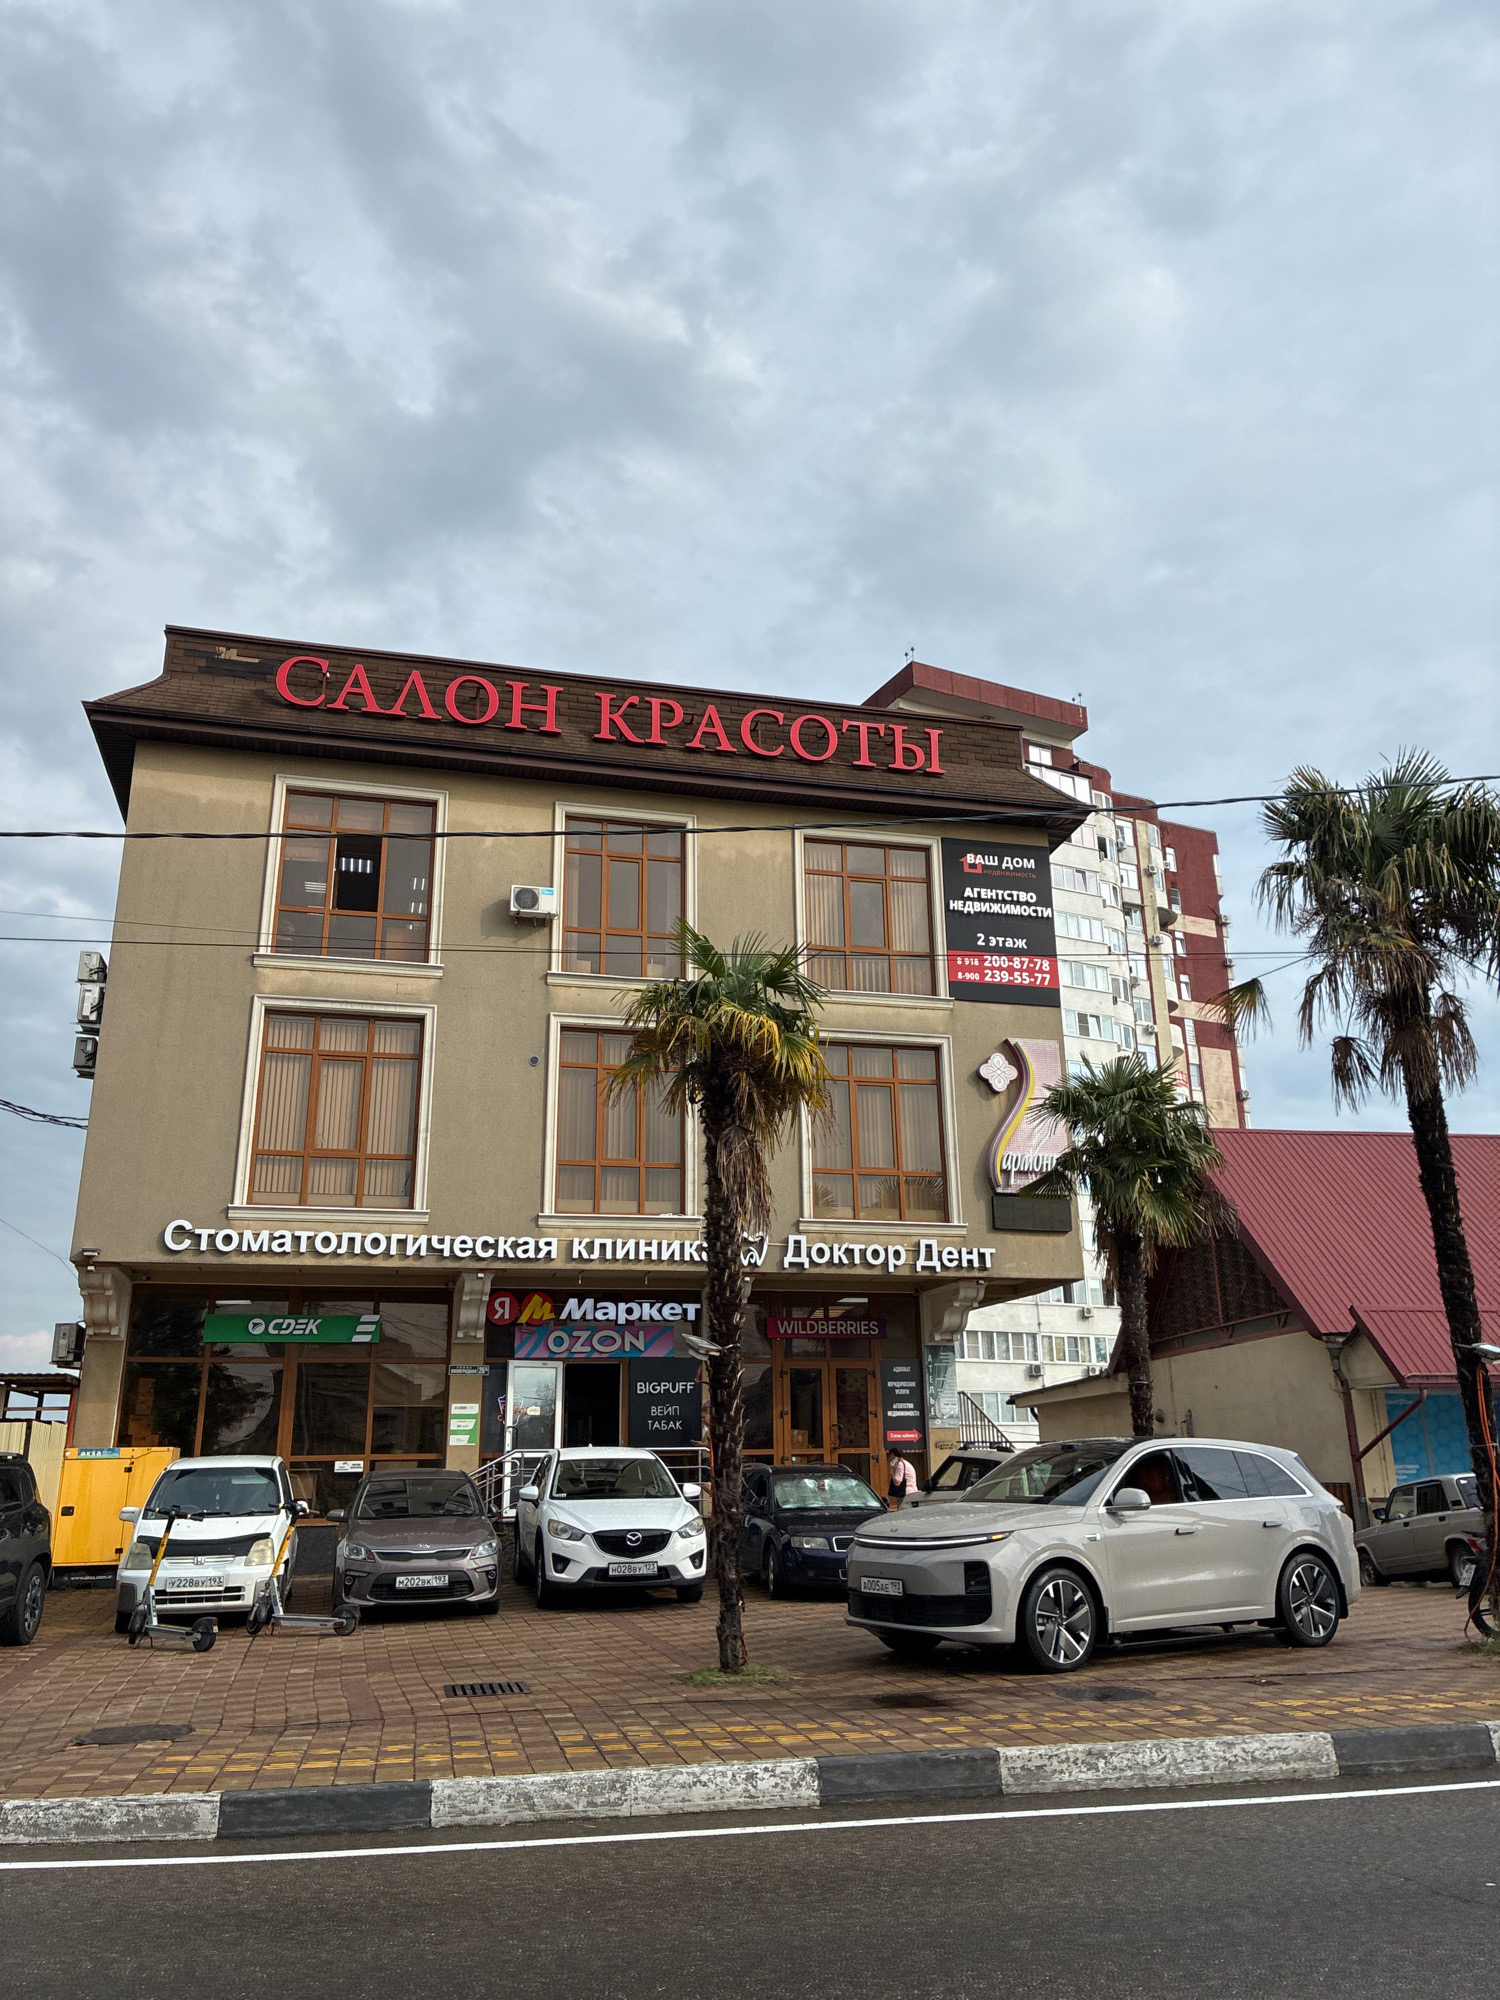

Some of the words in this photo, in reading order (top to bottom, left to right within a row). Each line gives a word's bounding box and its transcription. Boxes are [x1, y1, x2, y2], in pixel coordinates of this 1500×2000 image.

[276, 656, 564, 735] САЛОН
[594, 692, 946, 774] КРАСОТЫ
[966, 853, 998, 866] ВАШ
[1002, 856, 1036, 870] ДОМ
[983, 868, 1037, 879] недвижимость
[963, 887, 1037, 903] АГЕНТСТВО
[949, 899, 1053, 918] НЕДВИЖИМОСТИ
[976, 933, 986, 946] 2
[988, 936, 1028, 949] этаж
[956, 957, 963, 965] 8
[964, 958, 979, 966] 918
[983, 955, 1051, 971] 200-87-78
[957, 971, 980, 981] 8-900
[984, 969, 1051, 986] 239-55-77
[164, 1219, 558, 1260] Стоматологическая
[783, 1234, 908, 1274] Доктор
[916, 1239, 998, 1273] Дент
[493, 1297, 511, 1320] Я
[559, 1297, 702, 1325] Маркет
[267, 1318, 323, 1335] CDEK
[777, 1320, 880, 1335] WILDBERRIES
[547, 1329, 646, 1354] OZON
[636, 1381, 695, 1394] BIGPUFF
[650, 1404, 680, 1416] ВЕЙП
[647, 1420, 683, 1430] ТАБАК
[611, 1564, 643, 1574] Н028ВУ
[644, 1563, 656, 1571] 123
[170, 1578, 206, 1588] У228ВУ
[208, 1577, 222, 1585] 193
[398, 1577, 432, 1588] М202ВК
[433, 1575, 447, 1583] 193
